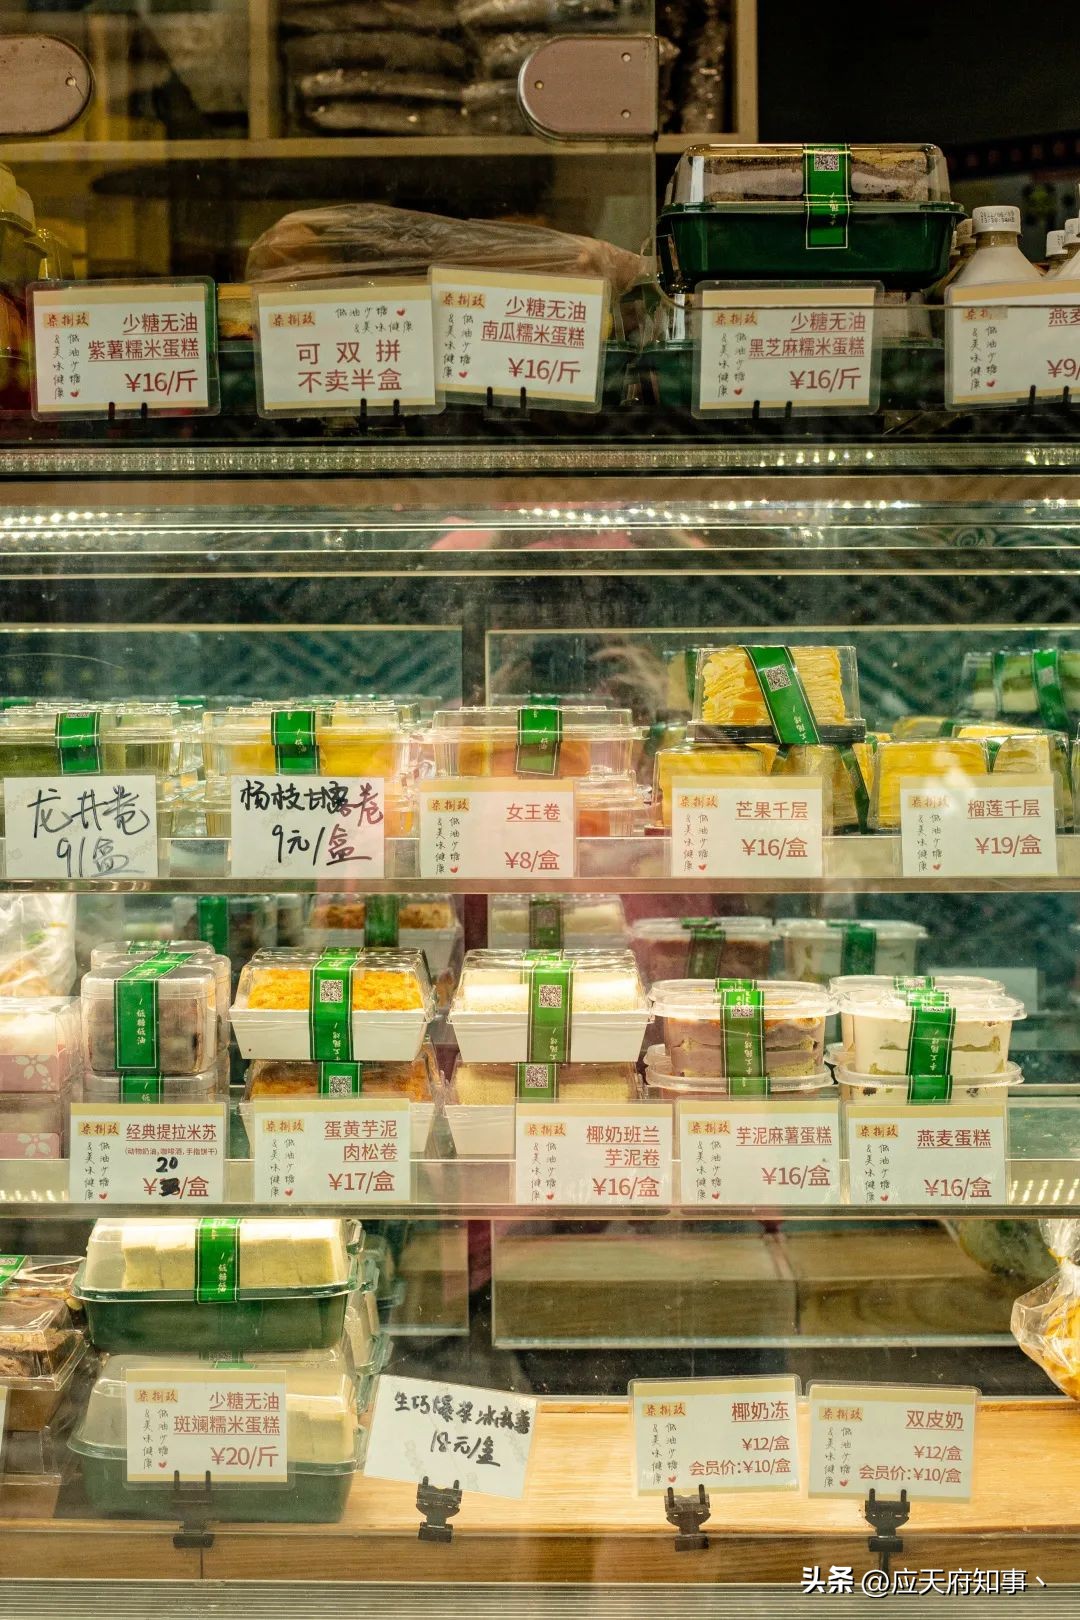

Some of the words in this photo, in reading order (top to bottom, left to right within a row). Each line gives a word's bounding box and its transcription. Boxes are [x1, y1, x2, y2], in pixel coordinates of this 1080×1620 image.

[506, 296, 586, 320] 少糖无油
[123, 313, 197, 333] 少糖无油
[791, 312, 865, 331] 少糖无油
[482, 321, 584, 346] 南瓜糯米蛋糕
[88, 338, 199, 360] 紫薯糯米蛋糕
[296, 339, 400, 365] 可双拼
[749, 337, 864, 357] 黑芝麻糯米蛋糕
[298, 368, 402, 393] 不卖半盒
[508, 358, 581, 384] ¥16/斤
[790, 368, 861, 392] ¥16/斤
[125, 370, 198, 395] ¥16/斤
[506, 803, 560, 820] 女王卷
[736, 801, 808, 818] 芒果千层
[968, 800, 1040, 817] 榴莲千层
[272, 824, 372, 866] 9元/盒
[741, 837, 808, 860] ¥16/盒
[975, 834, 1041, 857] ¥19/盒
[505, 850, 560, 872] ¥8/盒
[126, 1123, 216, 1140] 经典提拉米苏
[324, 1120, 397, 1137] 蛋黄芋泥
[587, 1125, 660, 1143] 椰奶班兰
[737, 1126, 831, 1144] 芋泥麻薯蛋糕
[917, 1129, 991, 1147] 燕麦蛋糕
[343, 1143, 398, 1161] 肉松卷
[606, 1148, 660, 1166] 芋泥卷
[156, 1157, 178, 1173] 20
[328, 1170, 395, 1194] ¥17/盒
[761, 1165, 830, 1188] ¥16/盒
[592, 1176, 659, 1199] ¥16/盒
[924, 1177, 991, 1200] ¥16/盒
[210, 1392, 280, 1410] 少糖无油
[732, 1401, 789, 1420] 椰奶冻
[174, 1416, 280, 1434] 斑斓糯米蛋糕
[906, 1410, 964, 1429] 双皮奶
[742, 1436, 790, 1452] ¥12/盒
[914, 1446, 962, 1461] ¥12/盒
[210, 1446, 278, 1469] ¥20/斤
